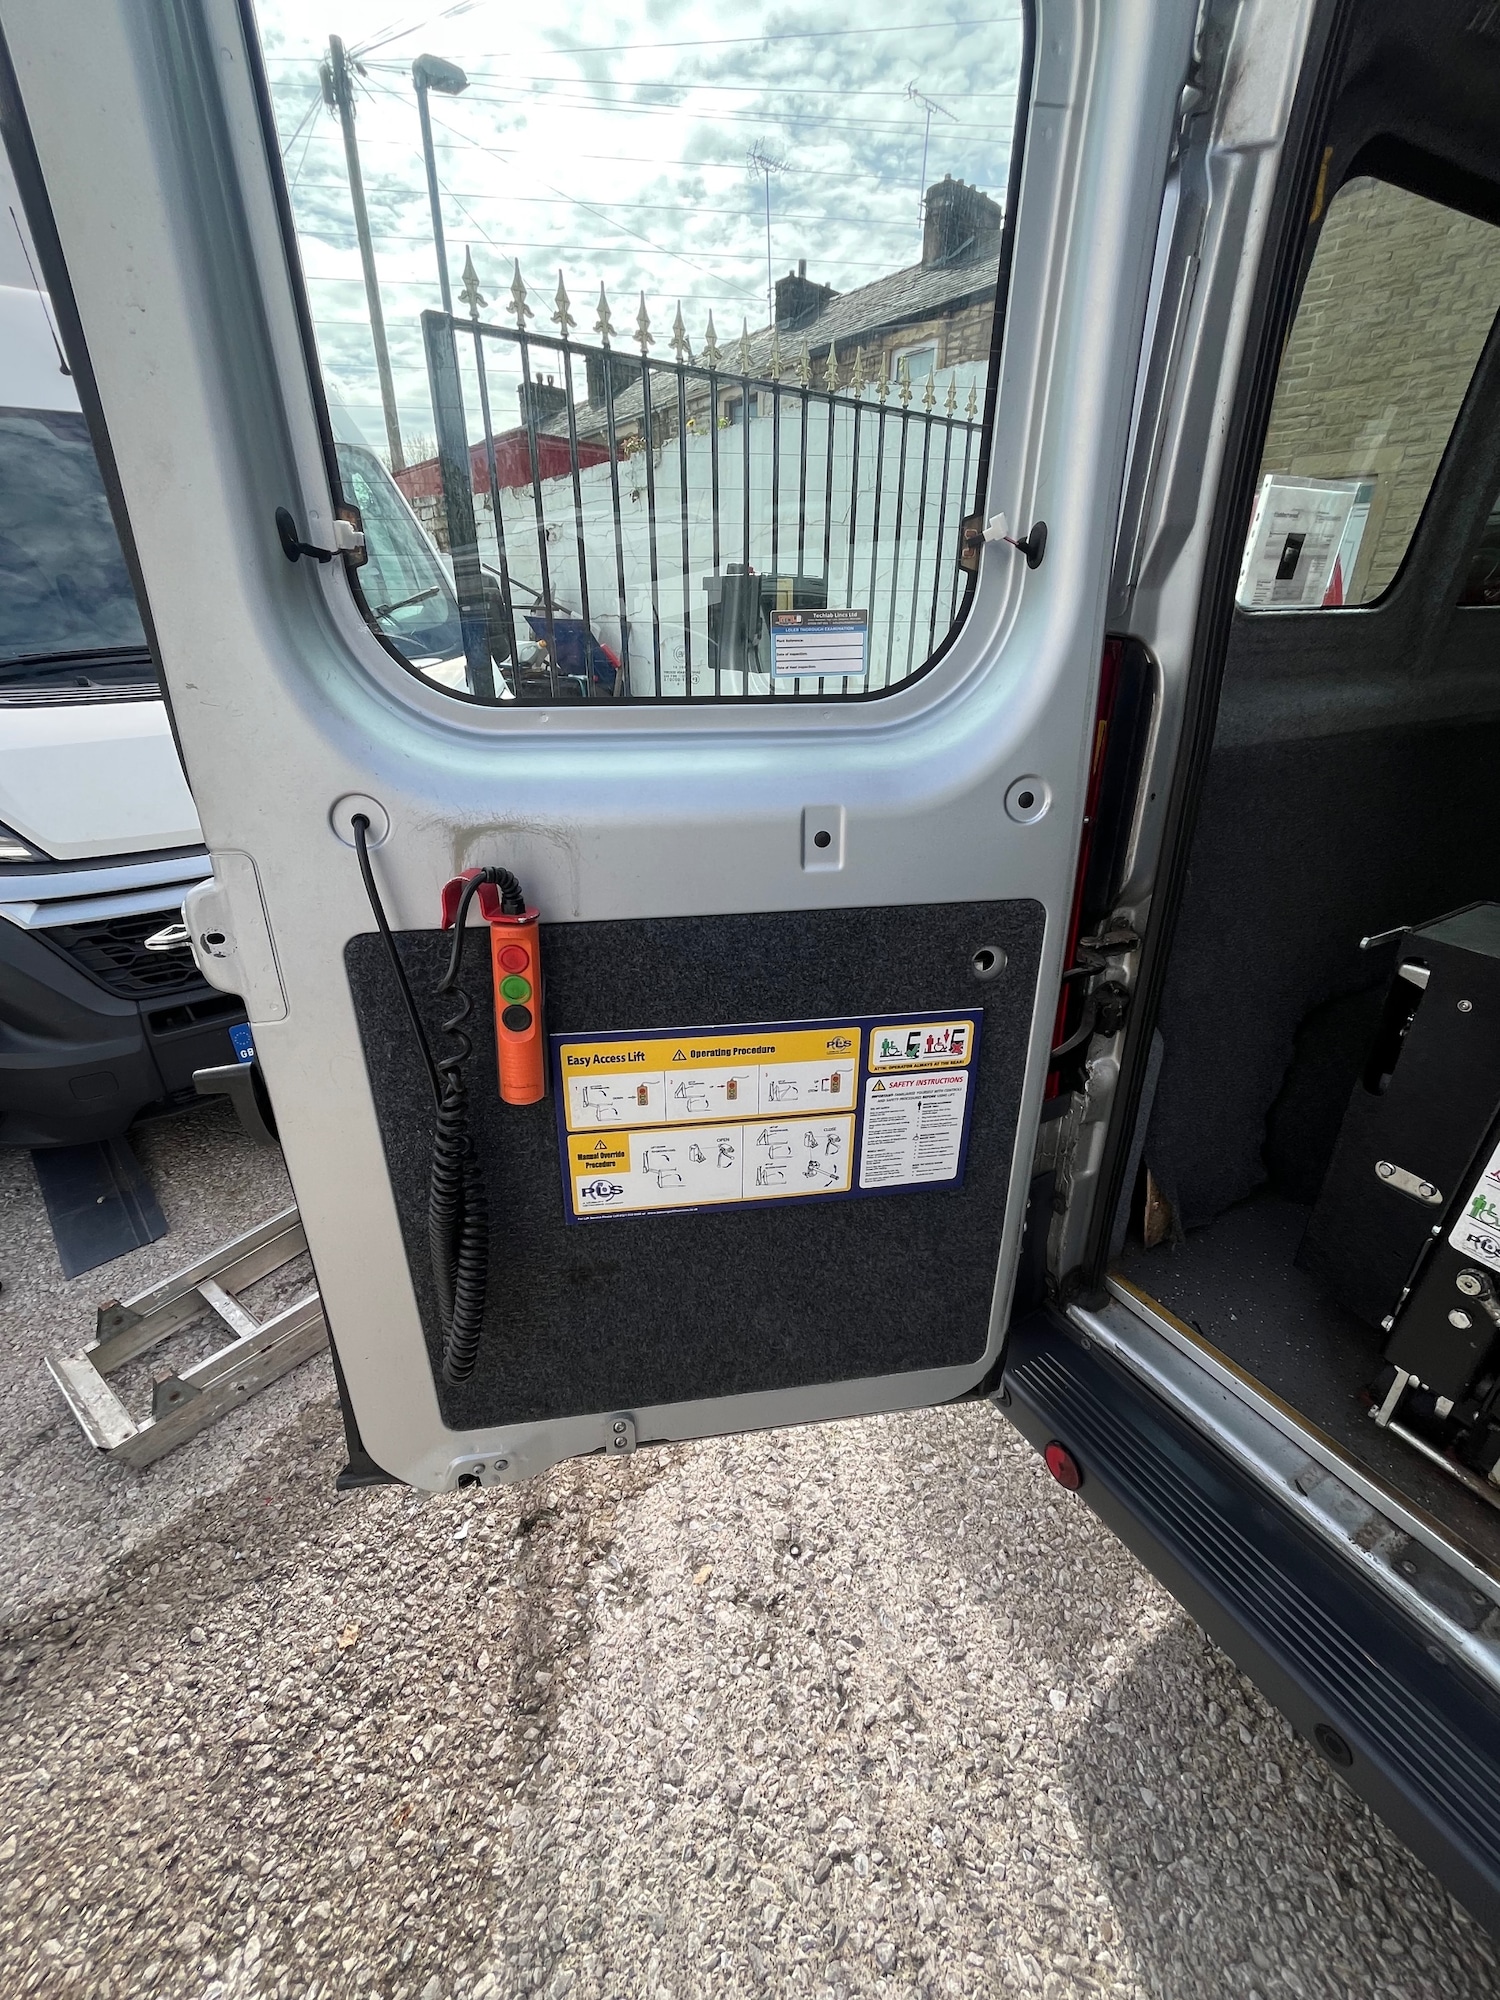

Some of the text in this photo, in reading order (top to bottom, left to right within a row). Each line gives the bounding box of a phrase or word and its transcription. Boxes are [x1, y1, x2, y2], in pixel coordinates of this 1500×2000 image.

[240, 1048, 254, 1058] GB
[690, 1046, 775, 1058] Operating Procedure
[567, 1051, 646, 1067] Easy Access Lift
[889, 1076, 964, 1089] SAFETY INSTRUCTIONS
[577, 1152, 599, 1161] Manual
[585, 1161, 616, 1169] Procedure
